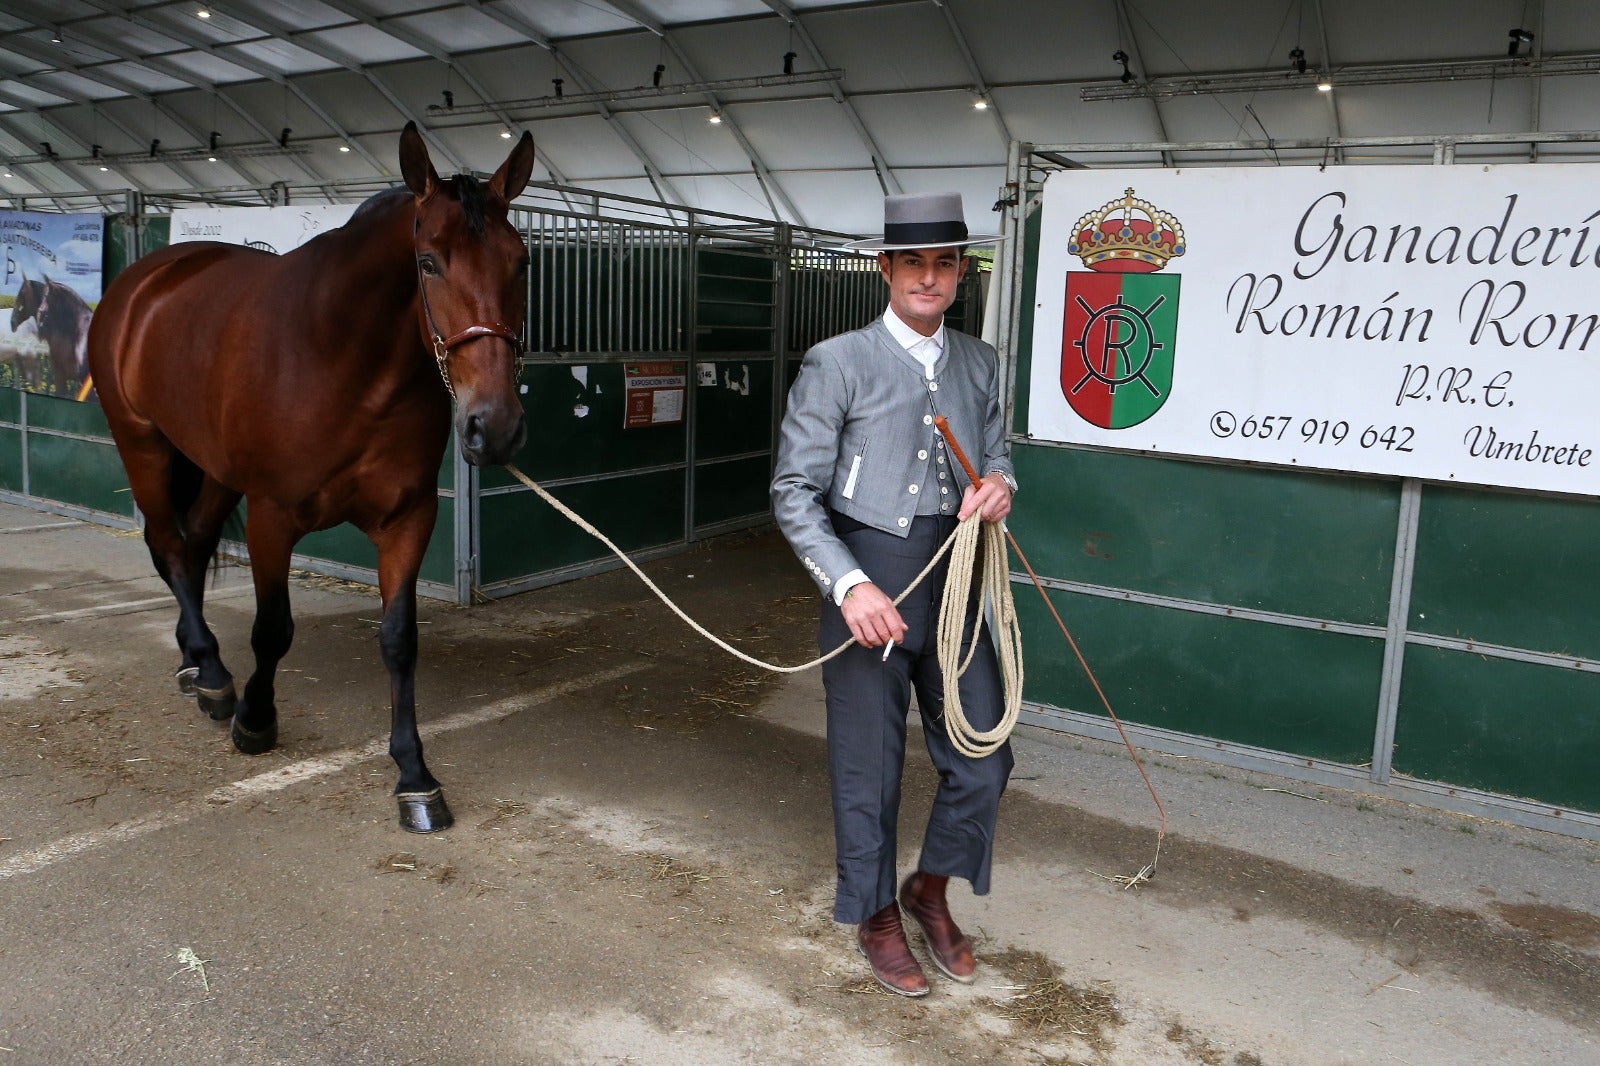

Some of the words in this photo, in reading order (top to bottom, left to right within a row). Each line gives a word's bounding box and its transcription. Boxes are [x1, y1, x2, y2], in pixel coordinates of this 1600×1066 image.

[1293, 191, 1600, 281] Ganaderí
[1227, 273, 1434, 343] Román
[1240, 414, 1293, 441] 657
[1300, 418, 1350, 446] 919
[1359, 424, 1415, 453] 642
[1463, 425, 1593, 467] Umbrete
